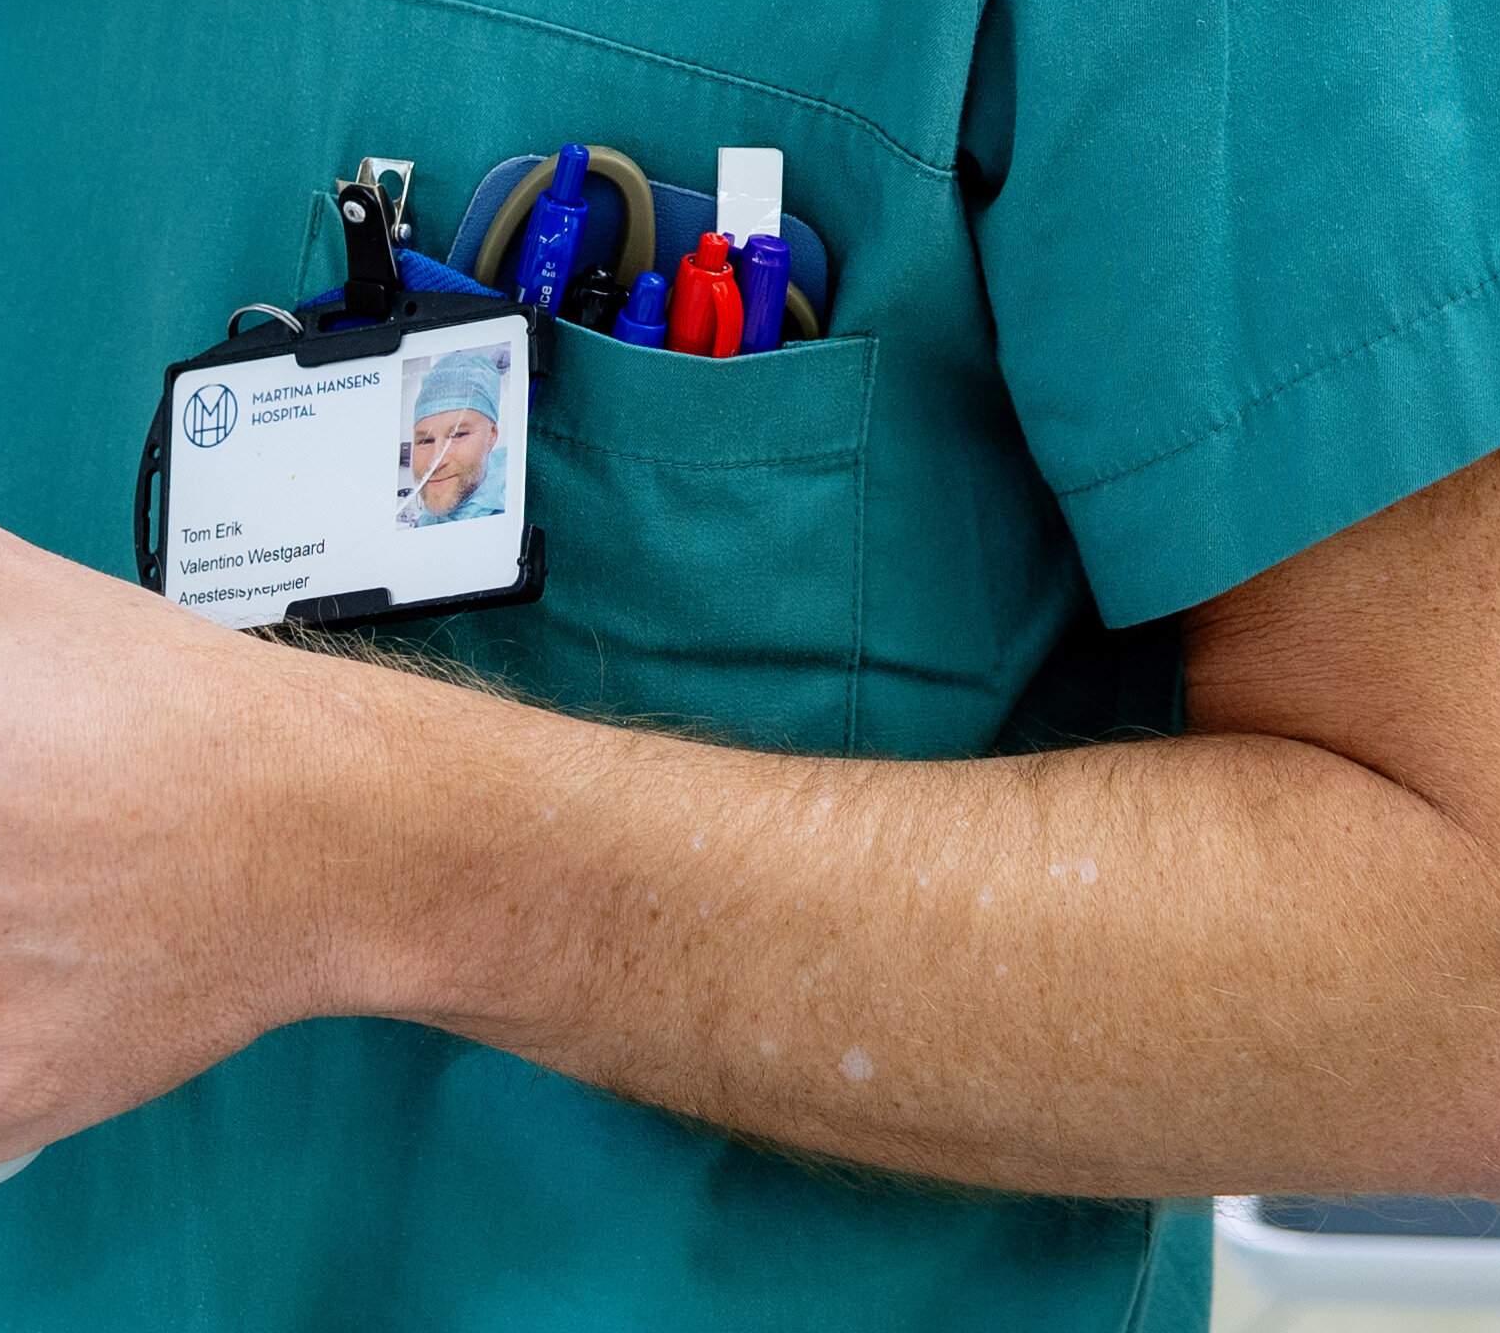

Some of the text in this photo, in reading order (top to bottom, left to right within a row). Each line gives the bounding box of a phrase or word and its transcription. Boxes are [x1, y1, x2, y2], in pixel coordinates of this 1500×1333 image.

[252, 371, 380, 405] MARTINA HANSENS
[251, 404, 316, 426] HOSPITAL
[182, 521, 243, 544] Tom Erik
[180, 539, 325, 575] Valentino Westgaard
